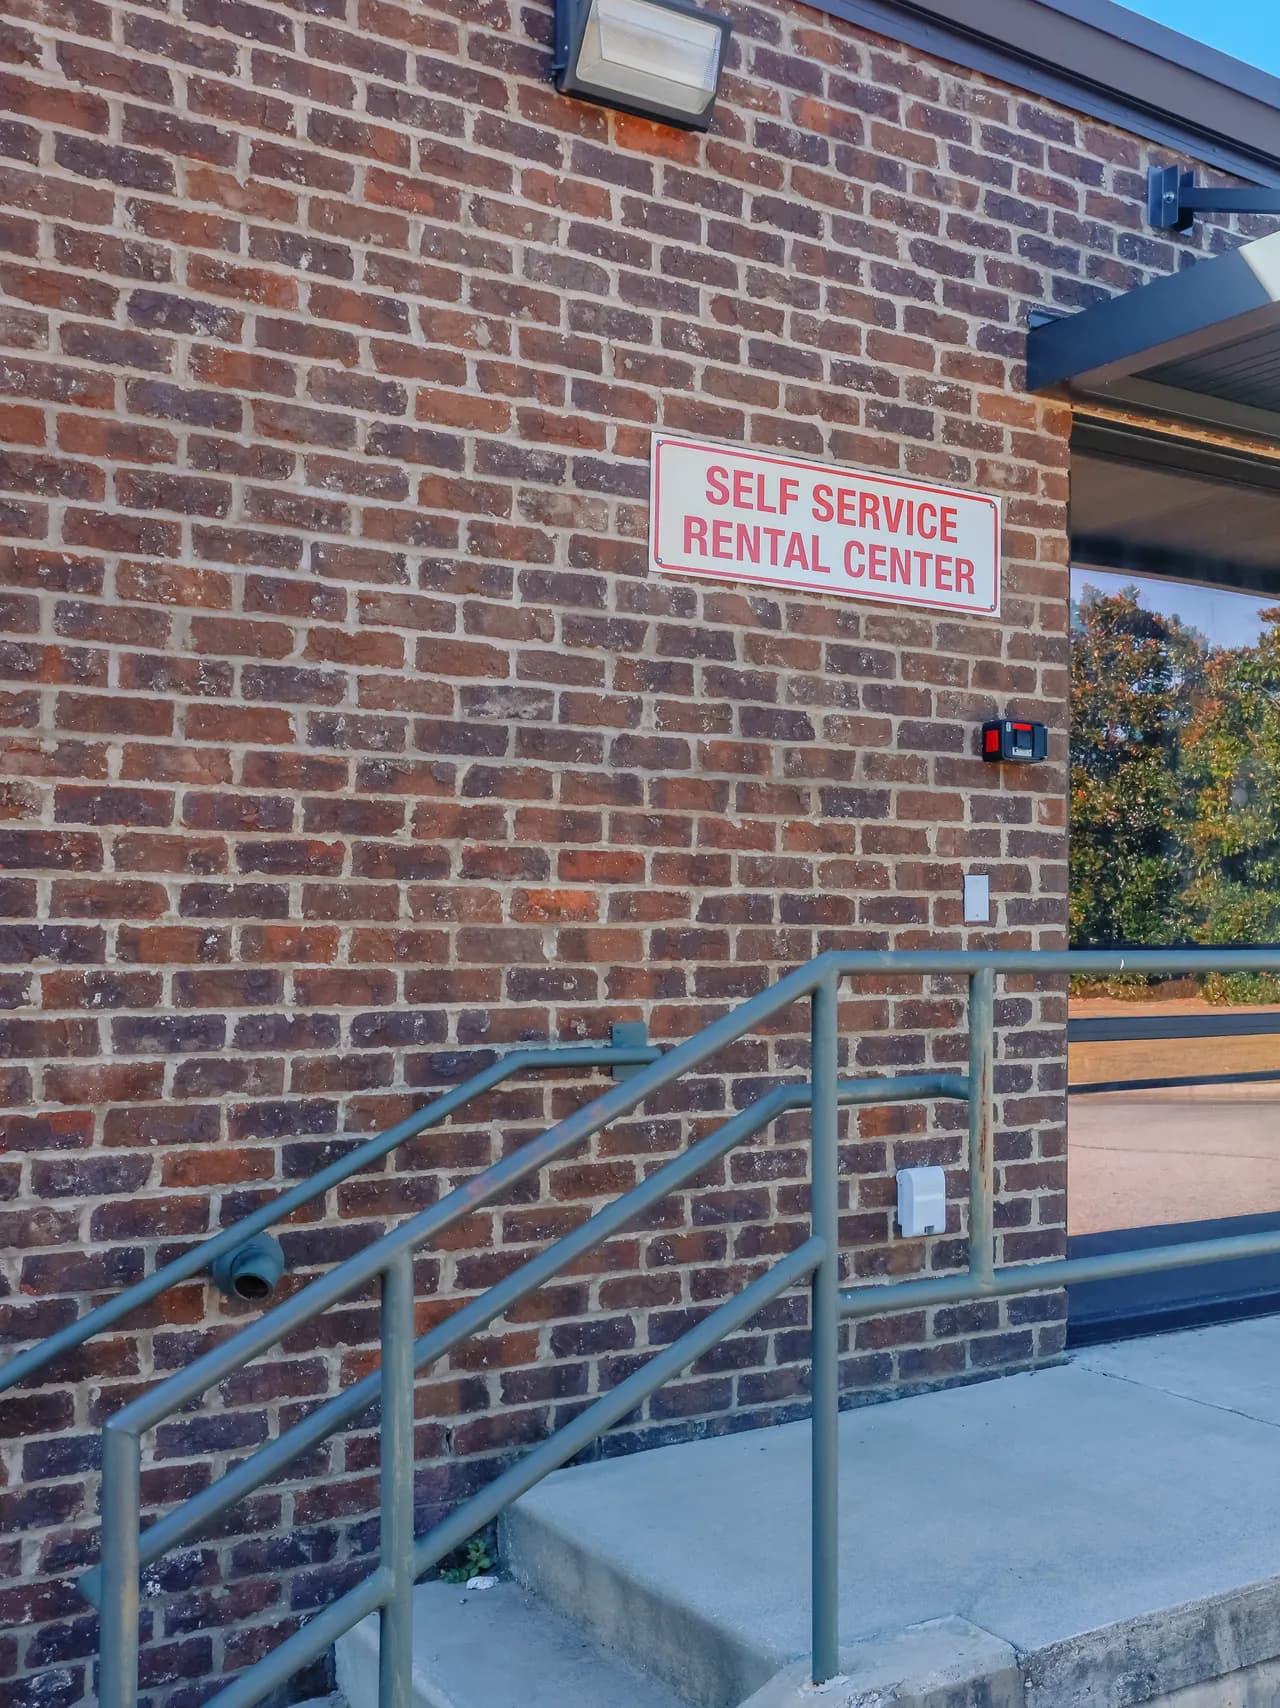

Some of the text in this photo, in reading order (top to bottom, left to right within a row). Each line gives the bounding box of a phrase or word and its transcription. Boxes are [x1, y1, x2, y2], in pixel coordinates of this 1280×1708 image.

[705, 465, 958, 544] SELF SERVICE
[683, 515, 976, 595] RENTAL CENTER
